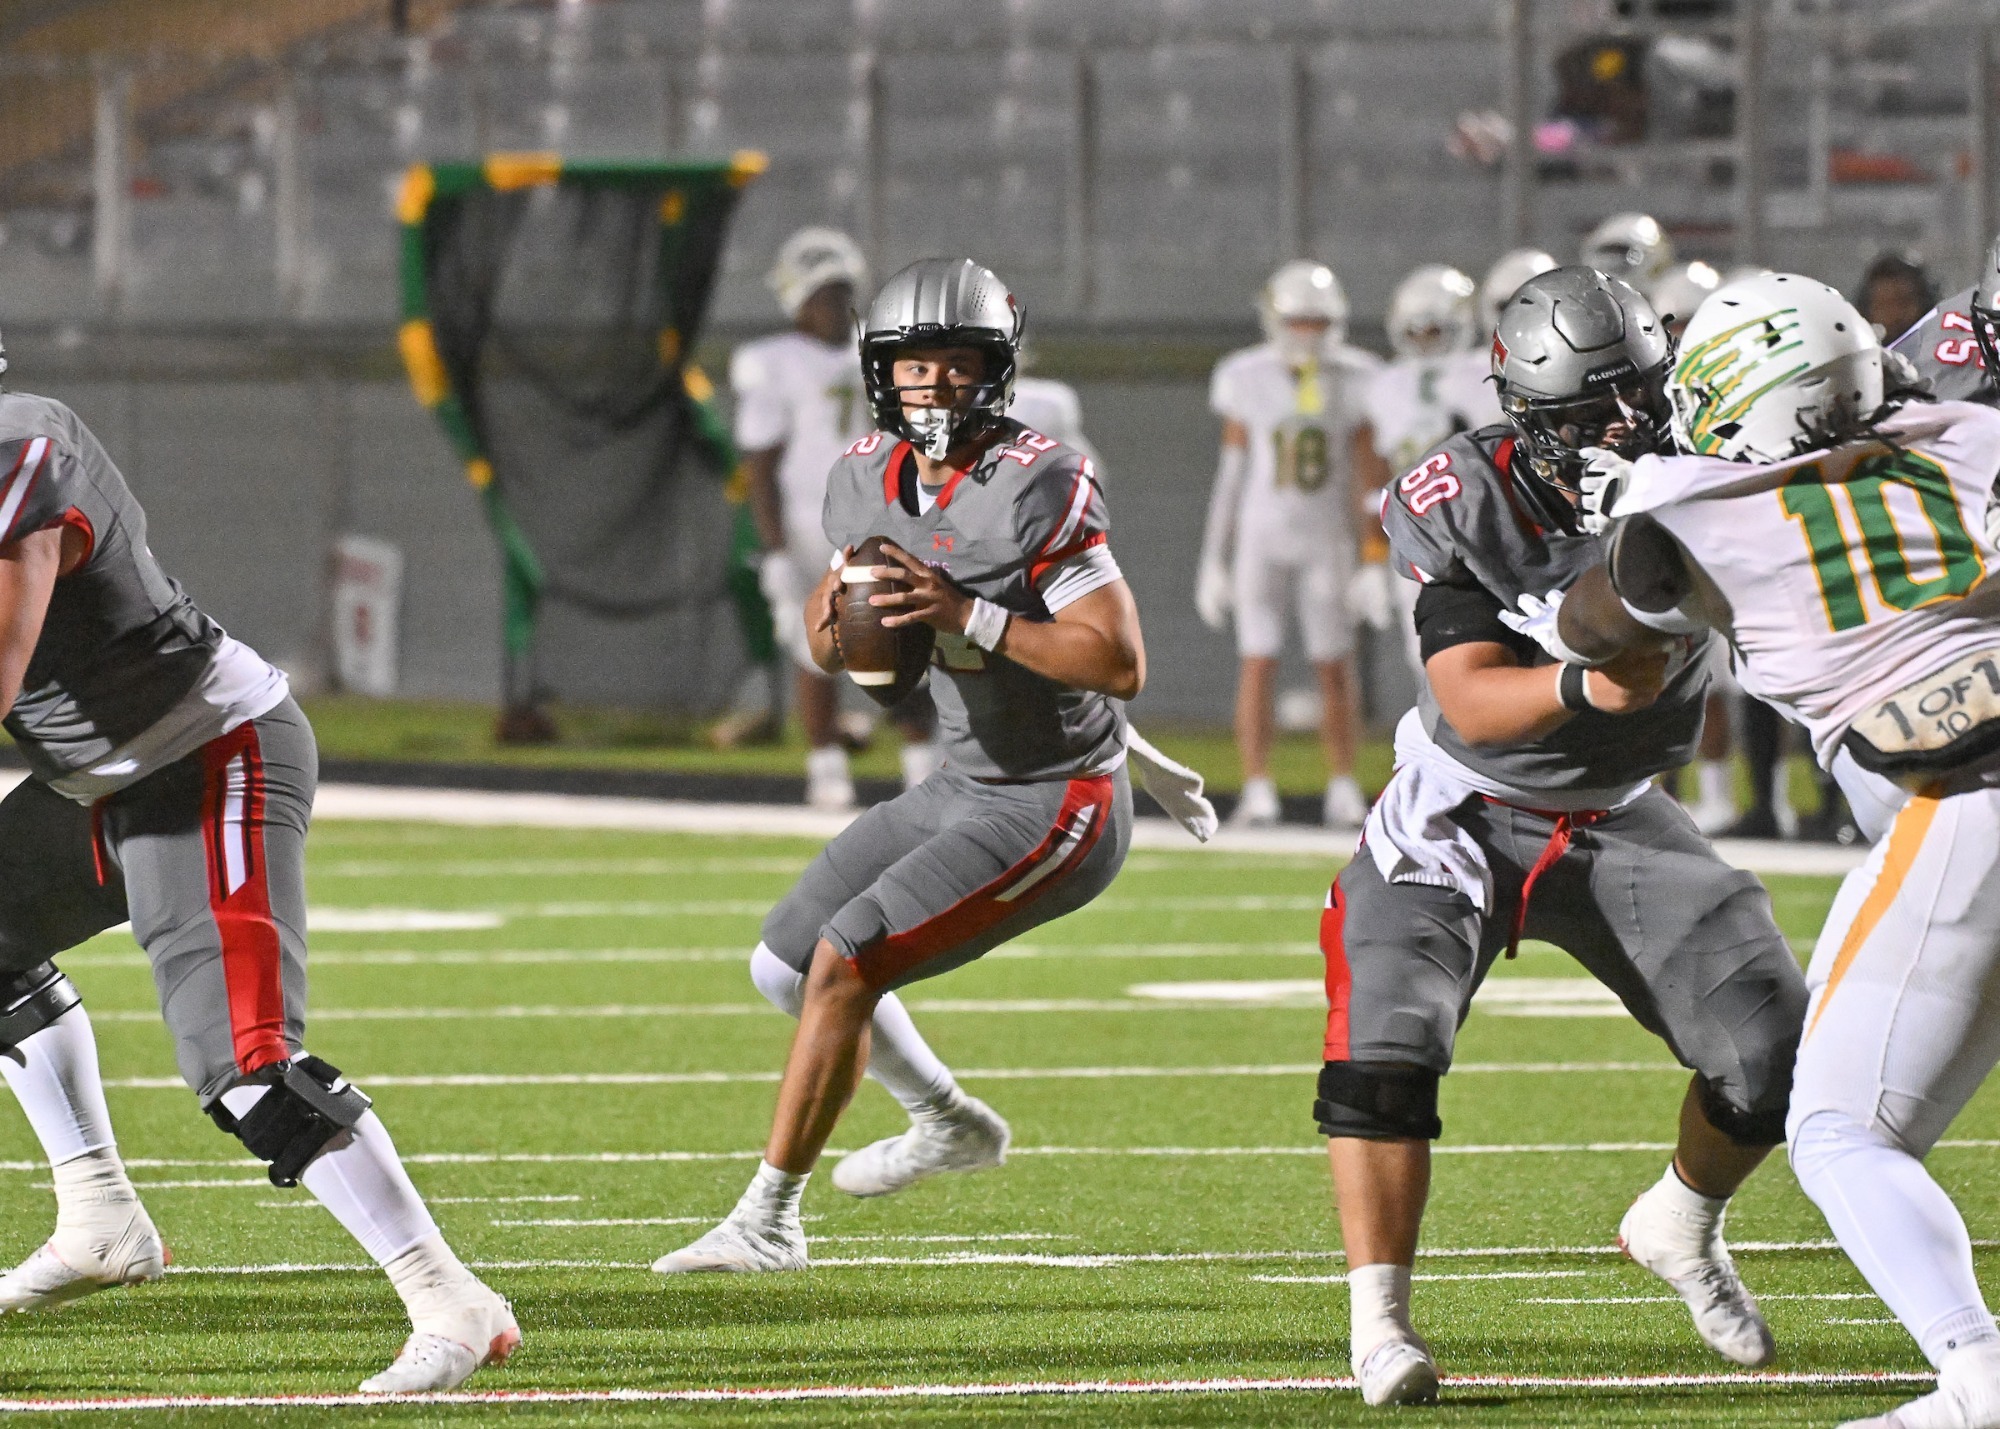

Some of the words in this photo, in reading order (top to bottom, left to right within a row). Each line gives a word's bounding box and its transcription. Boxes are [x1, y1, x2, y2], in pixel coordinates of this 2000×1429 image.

[997, 429, 1061, 468] 12
[1400, 451, 1462, 517] 60
[1776, 449, 1988, 633] 10
[1875, 701, 1915, 741] 1
[1918, 675, 1972, 717] OF
[1972, 659, 2000, 695] 1
[1937, 711, 1972, 741] 10
